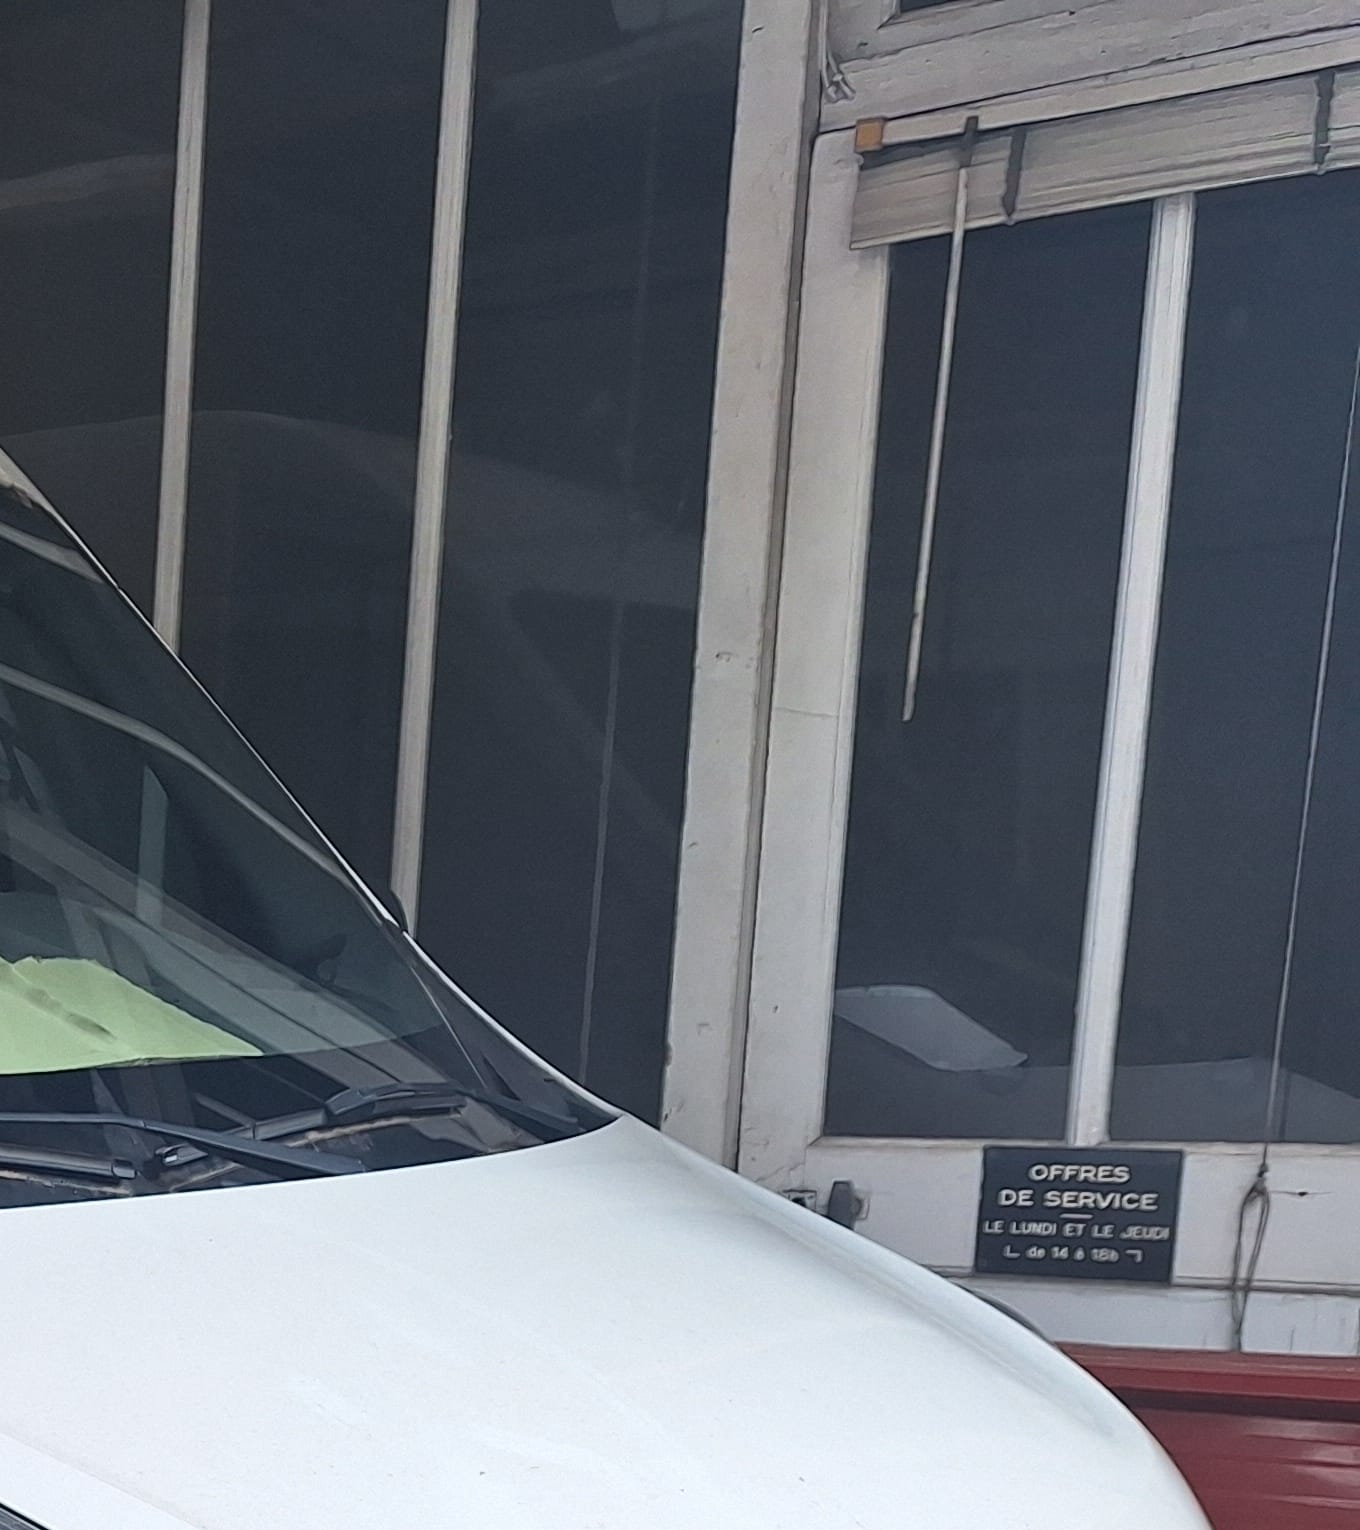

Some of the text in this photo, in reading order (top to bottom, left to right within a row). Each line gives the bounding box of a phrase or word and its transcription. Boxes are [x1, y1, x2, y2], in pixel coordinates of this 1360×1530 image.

[1030, 1164, 1130, 1183] OFFRES
[998, 1189, 1159, 1210] DE SERVICE
[983, 1220, 1170, 1240] LE LUNDI ET LE JEUDI
[1026, 1245, 1047, 1259] de
